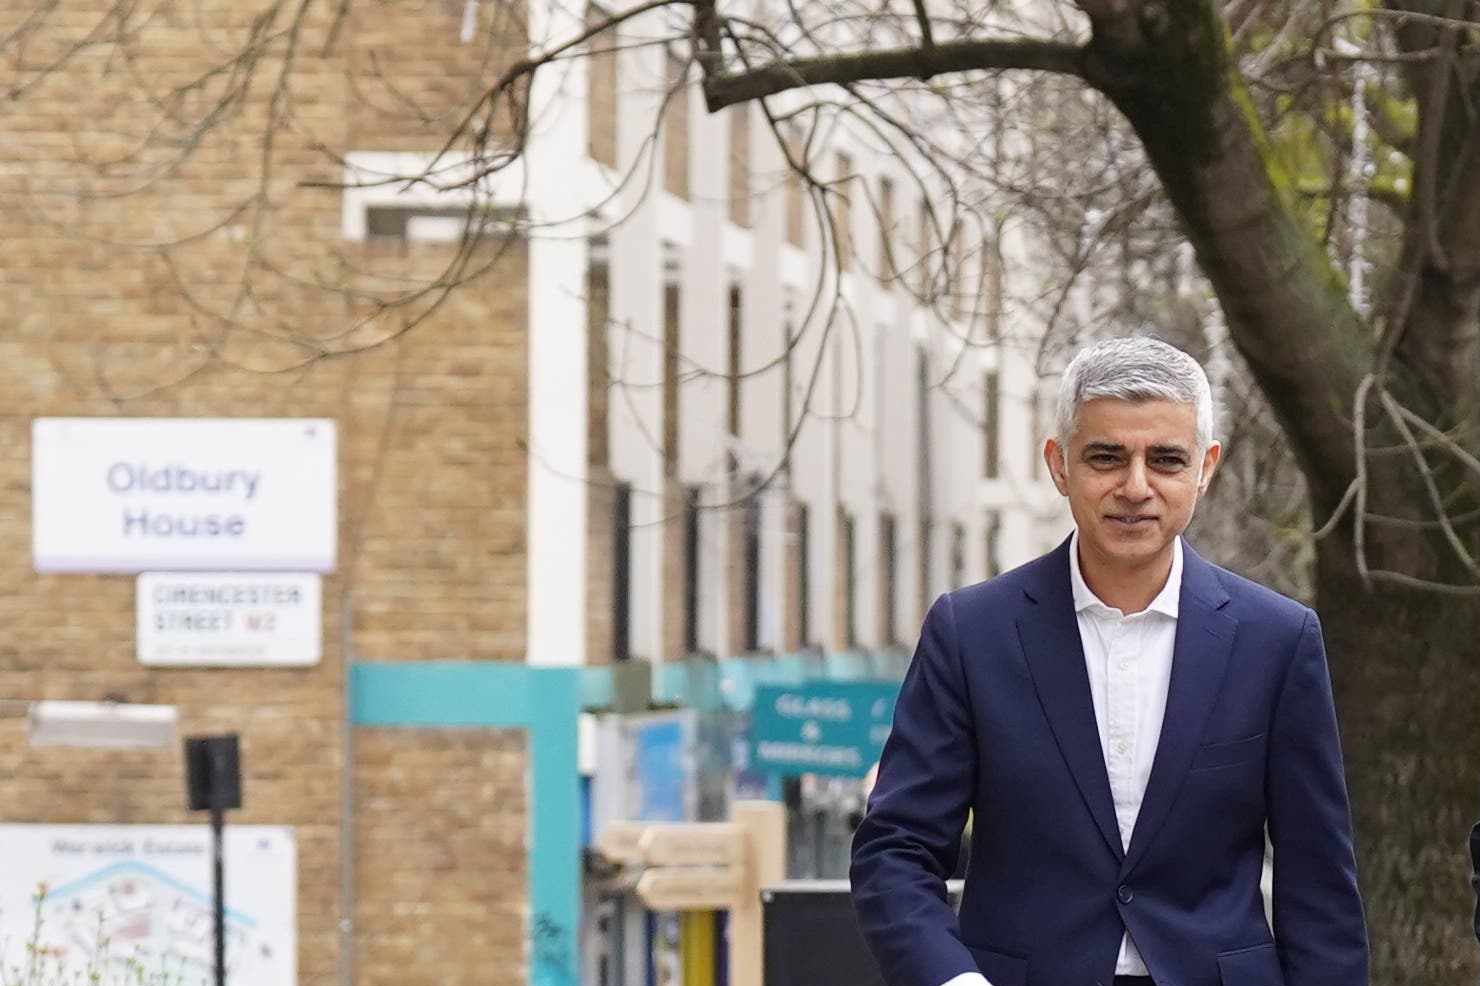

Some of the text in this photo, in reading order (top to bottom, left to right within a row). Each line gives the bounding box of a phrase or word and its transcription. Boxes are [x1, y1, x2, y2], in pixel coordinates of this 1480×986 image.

[106, 460, 261, 500] Oldbury
[122, 508, 247, 537] House
[153, 585, 302, 605] CIRENCESTER
[154, 611, 234, 632] STREET
[775, 694, 852, 721] GLASS
